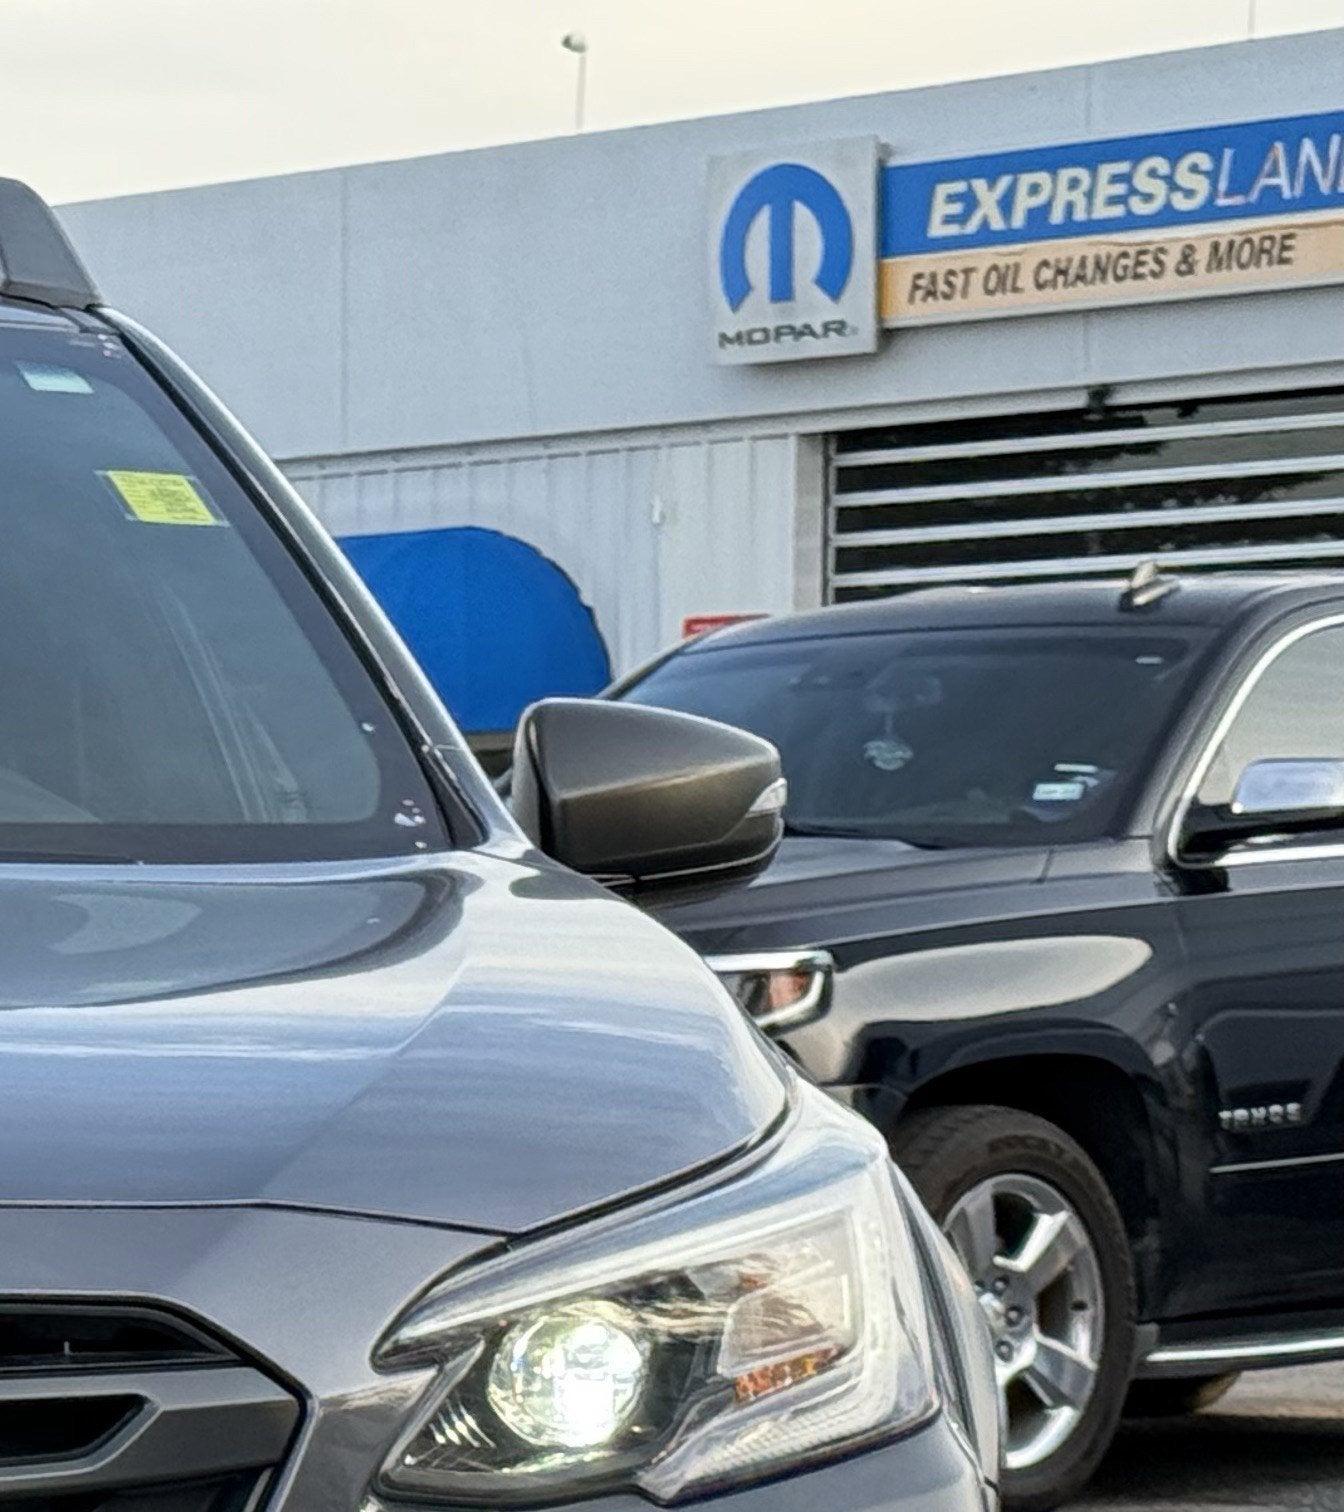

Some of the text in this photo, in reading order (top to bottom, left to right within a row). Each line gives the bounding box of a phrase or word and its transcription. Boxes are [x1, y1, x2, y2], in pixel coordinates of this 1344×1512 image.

[927, 134, 1344, 239] EXPRESSLAN
[907, 232, 1297, 305] FAST OIL CHANGES & MORE
[717, 319, 848, 349] MOPAR
